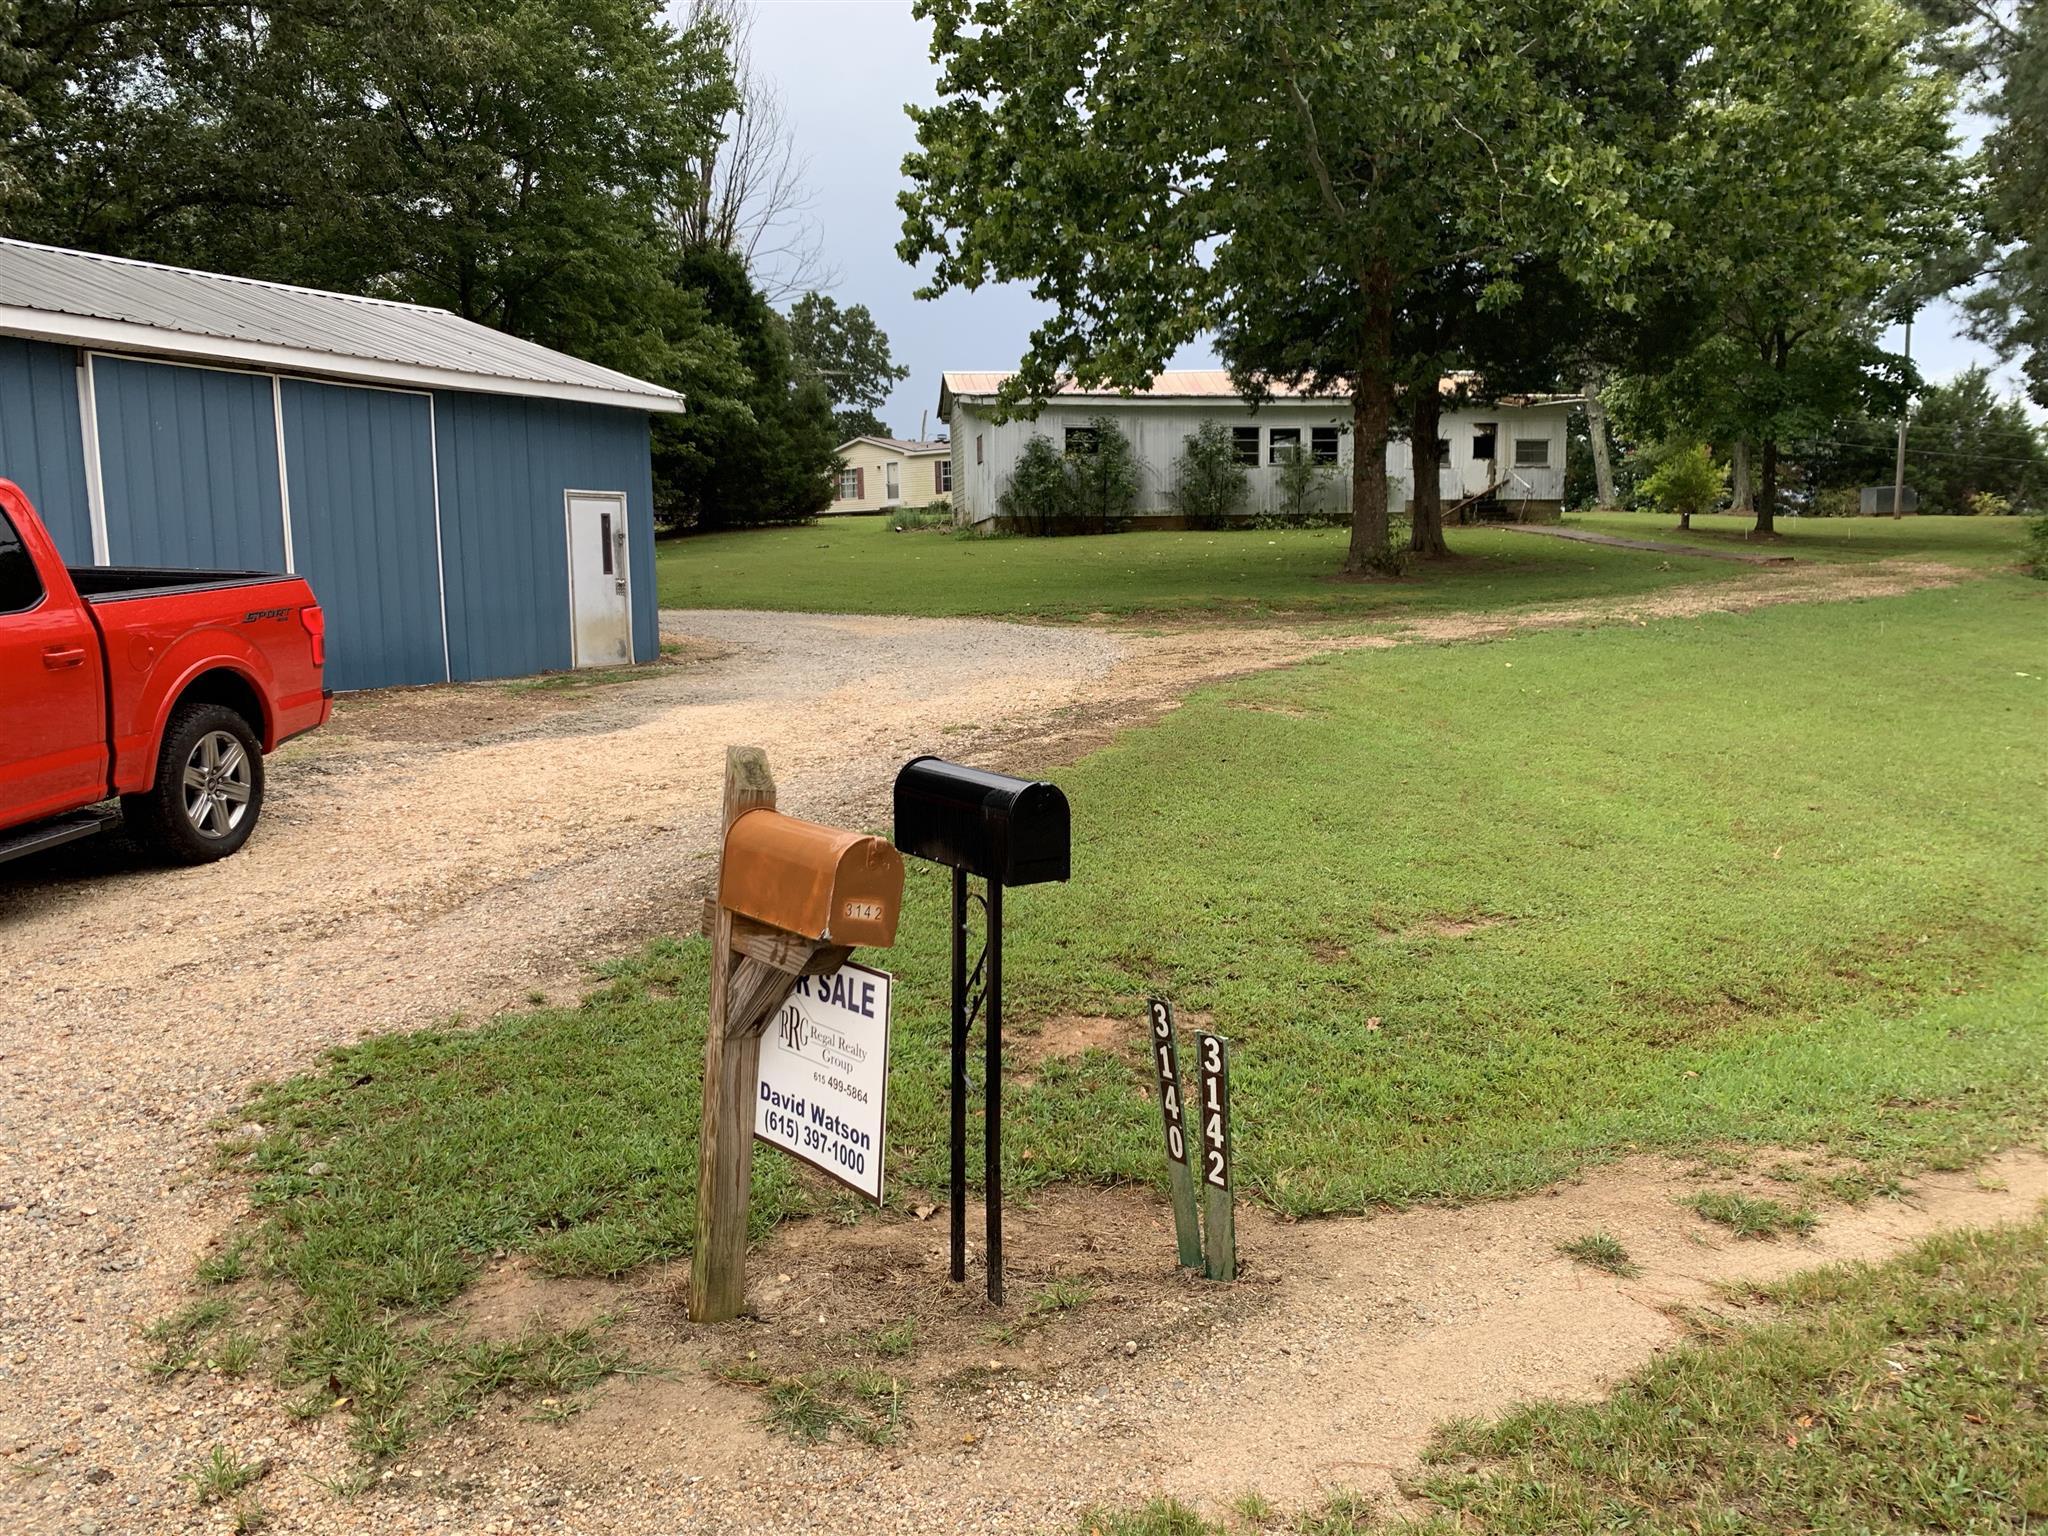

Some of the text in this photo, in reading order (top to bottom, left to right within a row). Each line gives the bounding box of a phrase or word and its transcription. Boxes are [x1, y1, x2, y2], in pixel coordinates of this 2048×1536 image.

[242, 607, 292, 623] SPORT
[845, 903, 882, 920] 3142
[818, 974, 875, 1019] SALE
[810, 1026, 867, 1060] Regal Realty
[822, 1048, 853, 1074] Group
[814, 1072, 868, 1104] 615 499-5864
[1153, 1003, 1183, 1159] 3140
[760, 1081, 870, 1150] David Watson
[1204, 1037, 1225, 1187] 3142
[765, 1109, 865, 1175] (615) 397-1000
